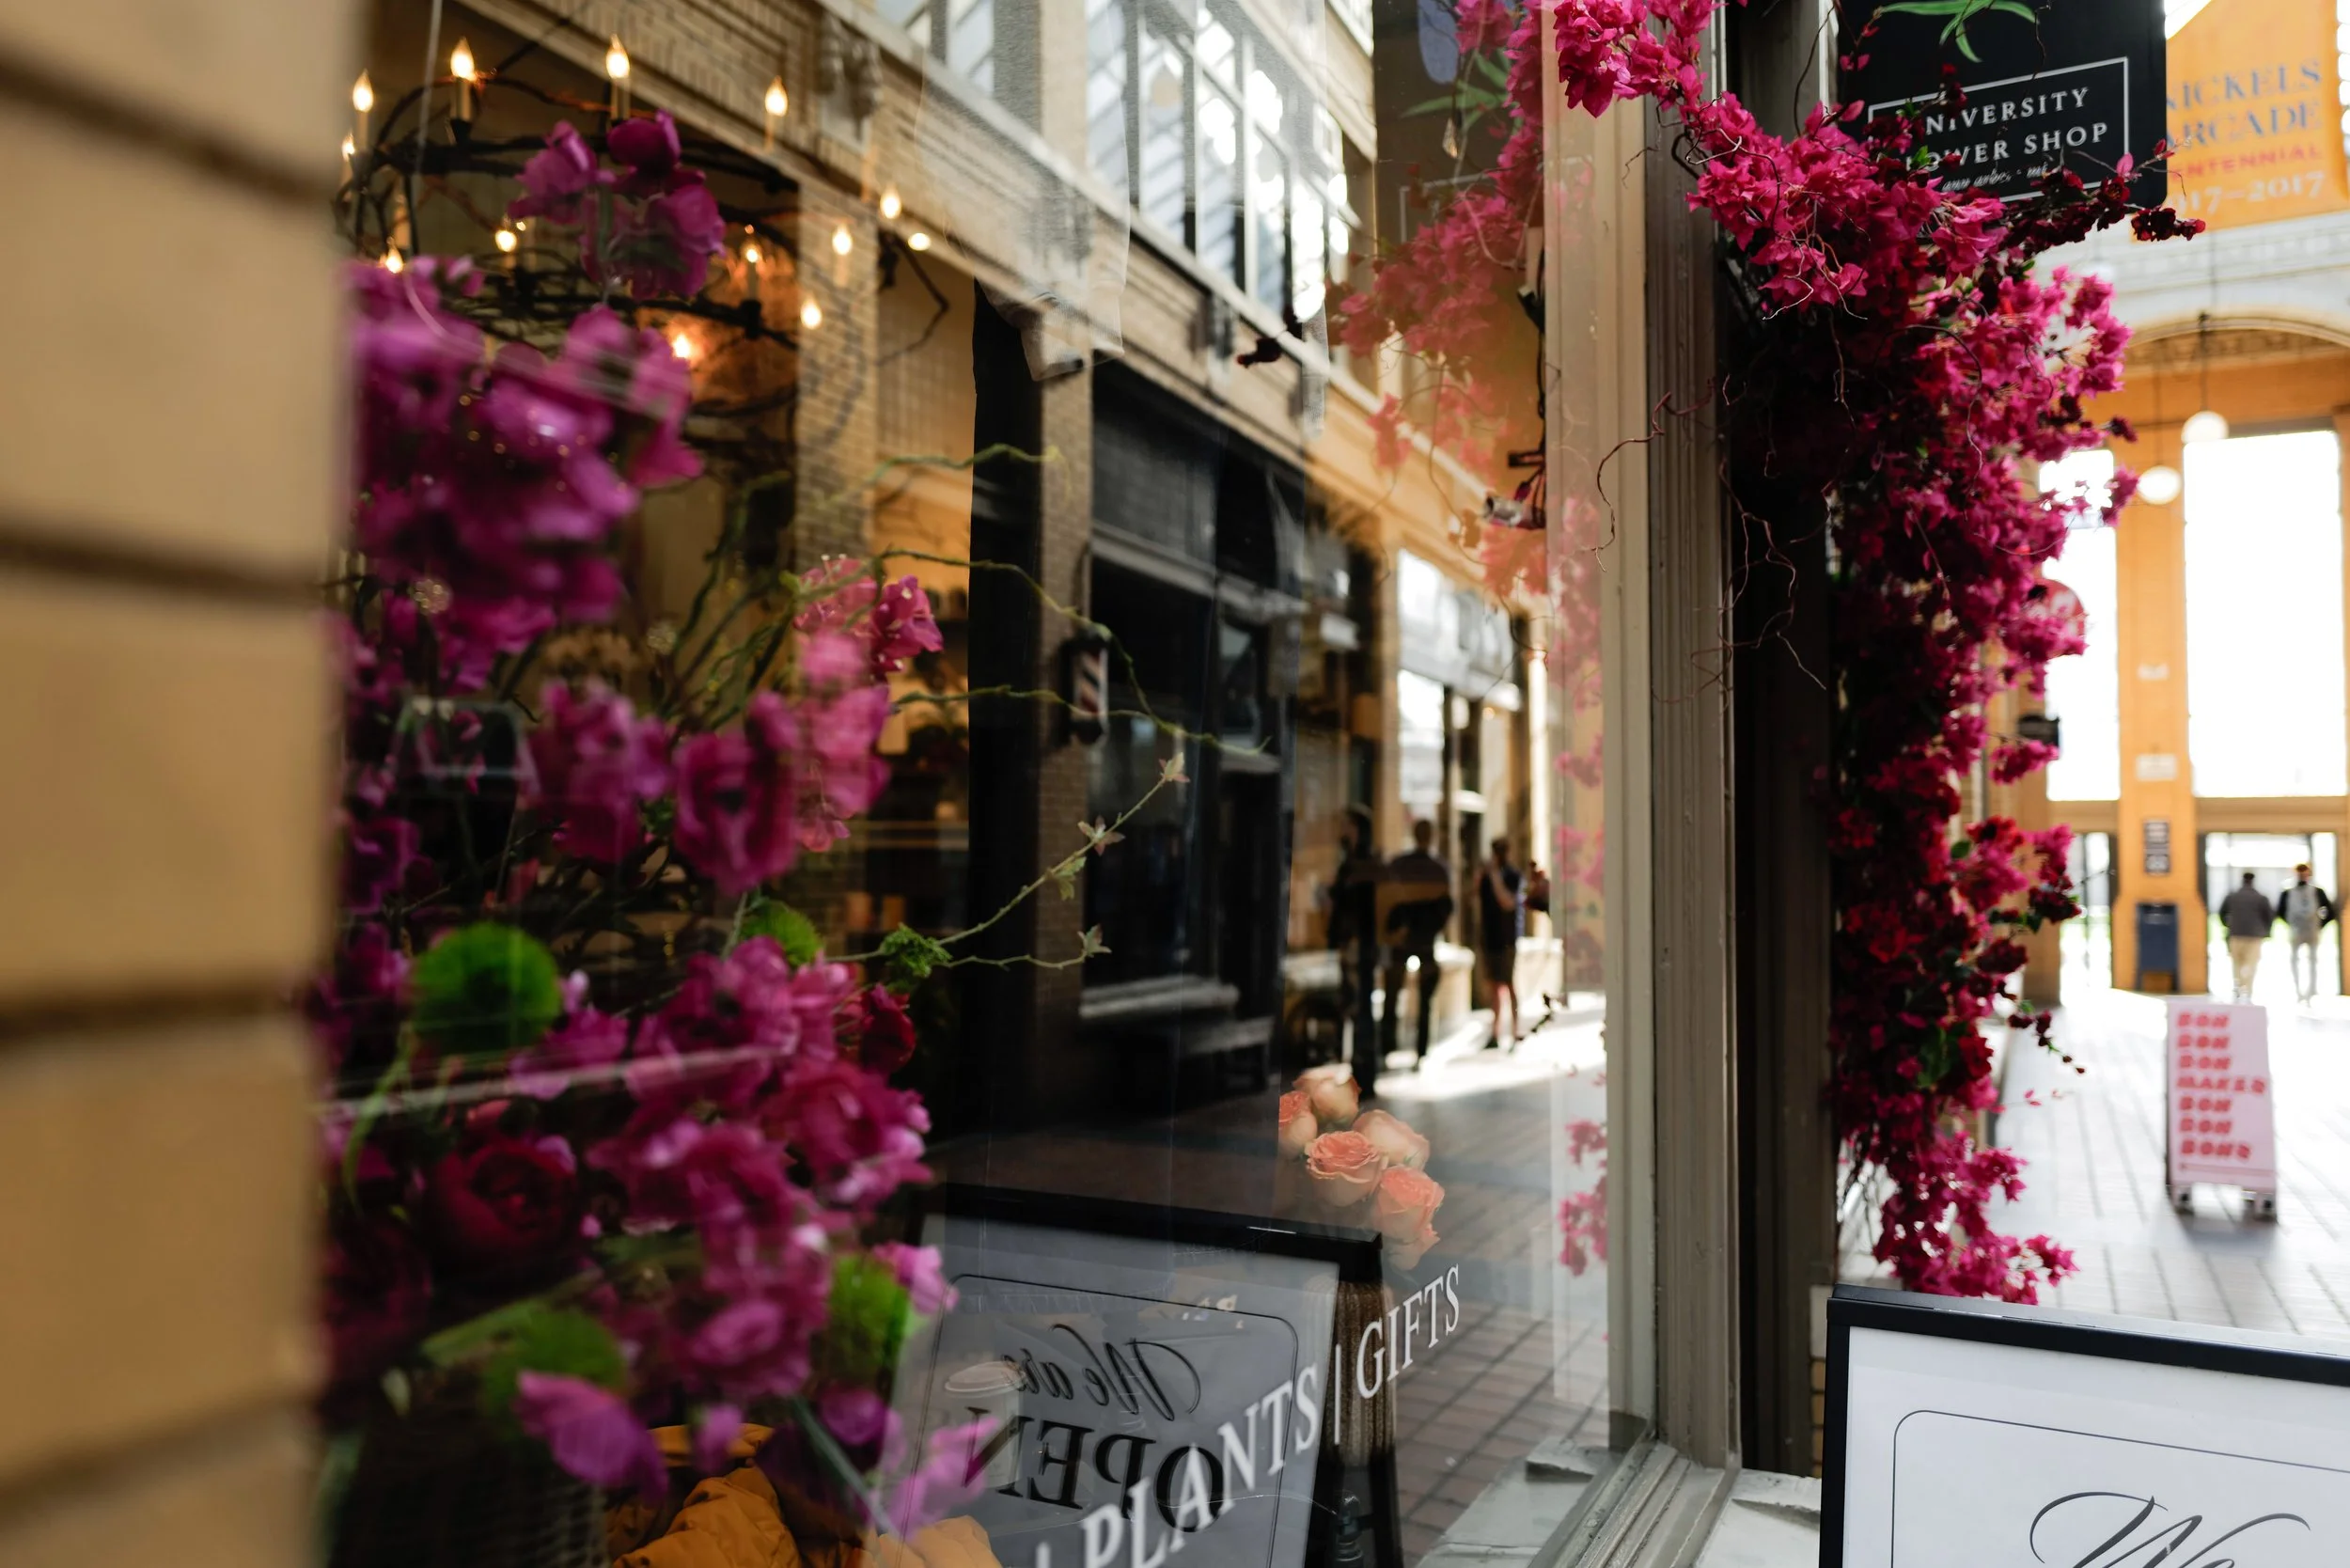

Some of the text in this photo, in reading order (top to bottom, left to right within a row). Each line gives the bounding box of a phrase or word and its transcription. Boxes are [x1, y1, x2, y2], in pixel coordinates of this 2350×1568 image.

[1925, 86, 2089, 135] NIVERSITY
[2024, 122, 2107, 154] SHOP
[2168, 144, 2322, 181] ENTENNIAL
[1083, 1263, 1460, 1568] PLANTS GIFTS
